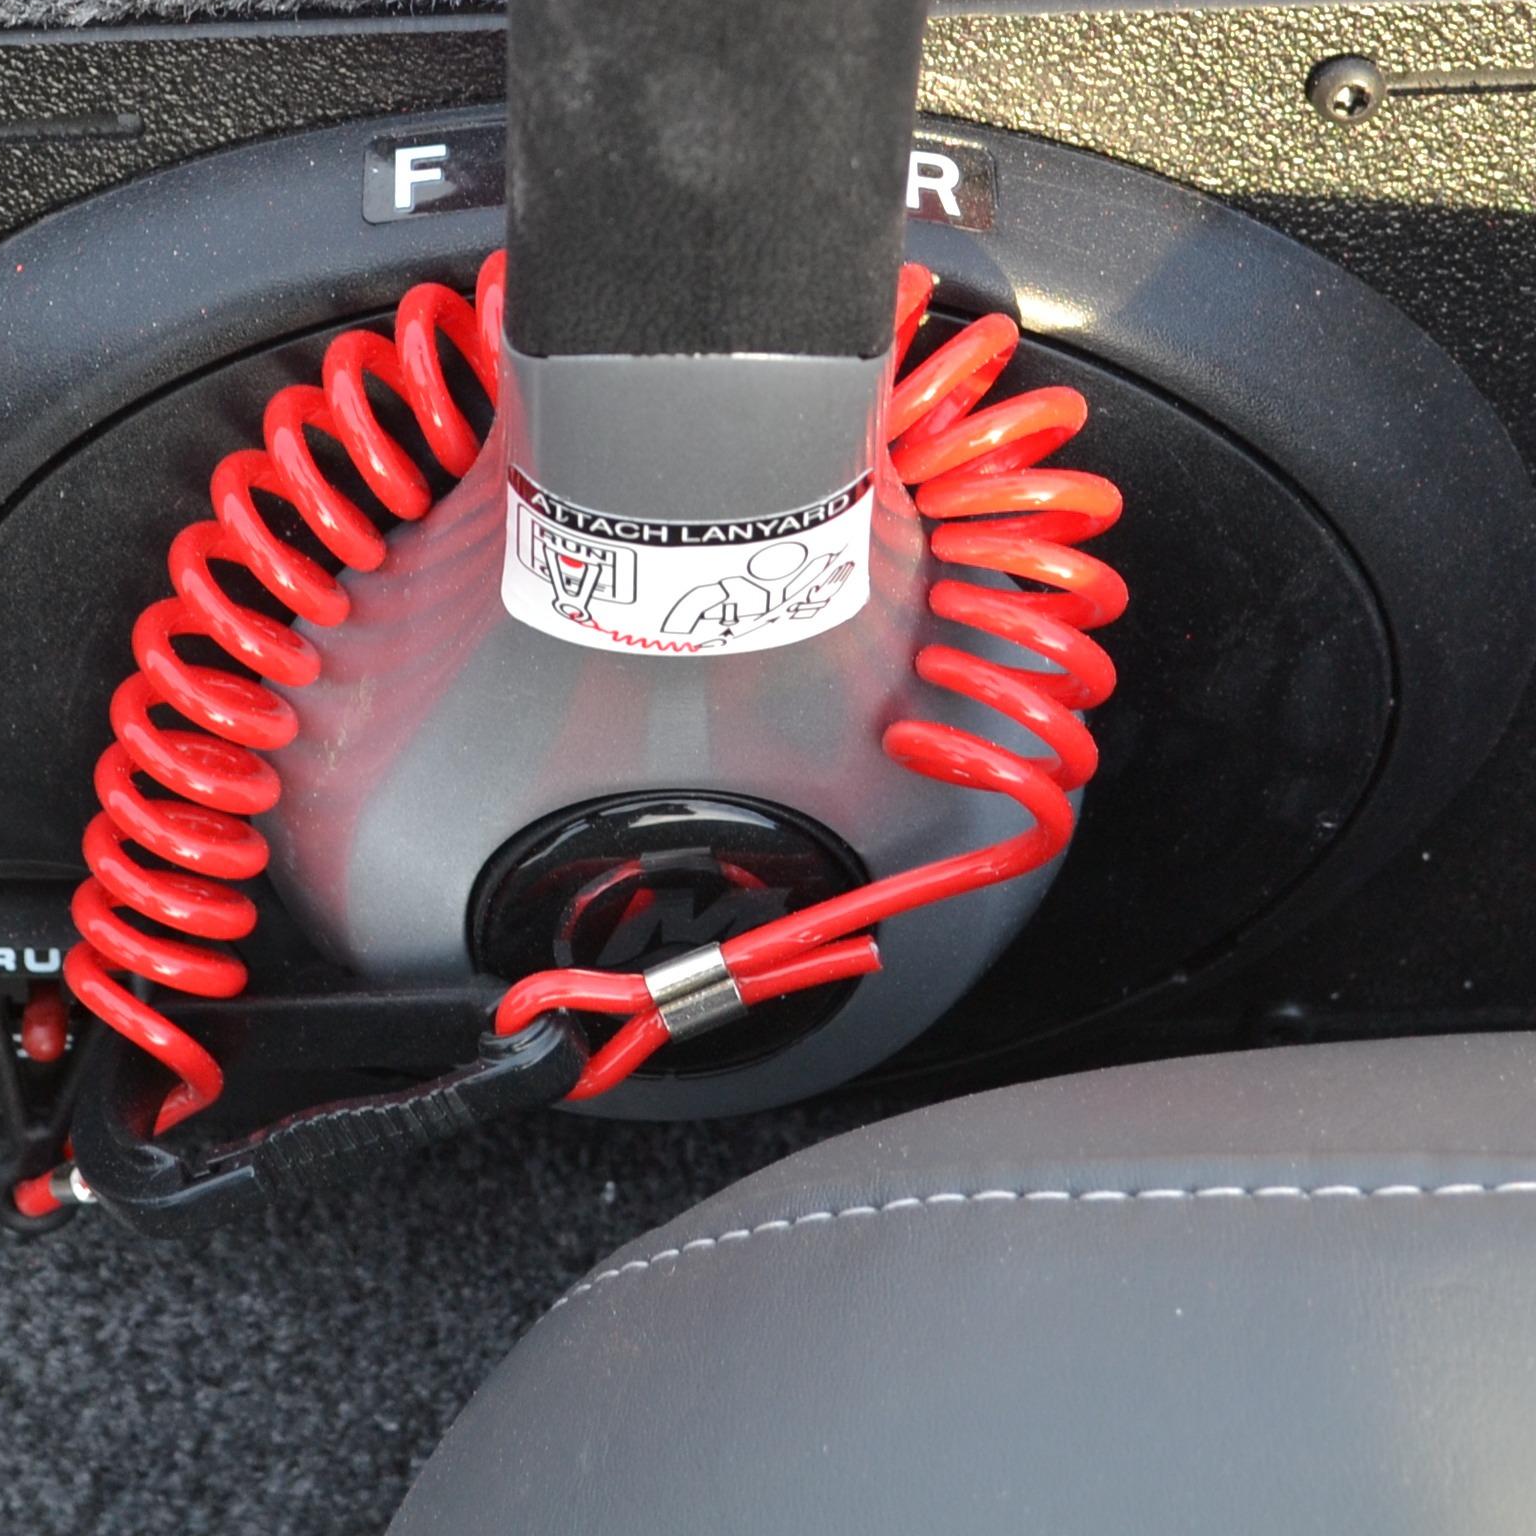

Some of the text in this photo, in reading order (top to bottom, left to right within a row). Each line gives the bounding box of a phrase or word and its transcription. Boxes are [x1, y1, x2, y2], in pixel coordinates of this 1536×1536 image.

[394, 144, 448, 212] F
[905, 150, 962, 217] R
[530, 493, 852, 544] ATTACH LANYARD
